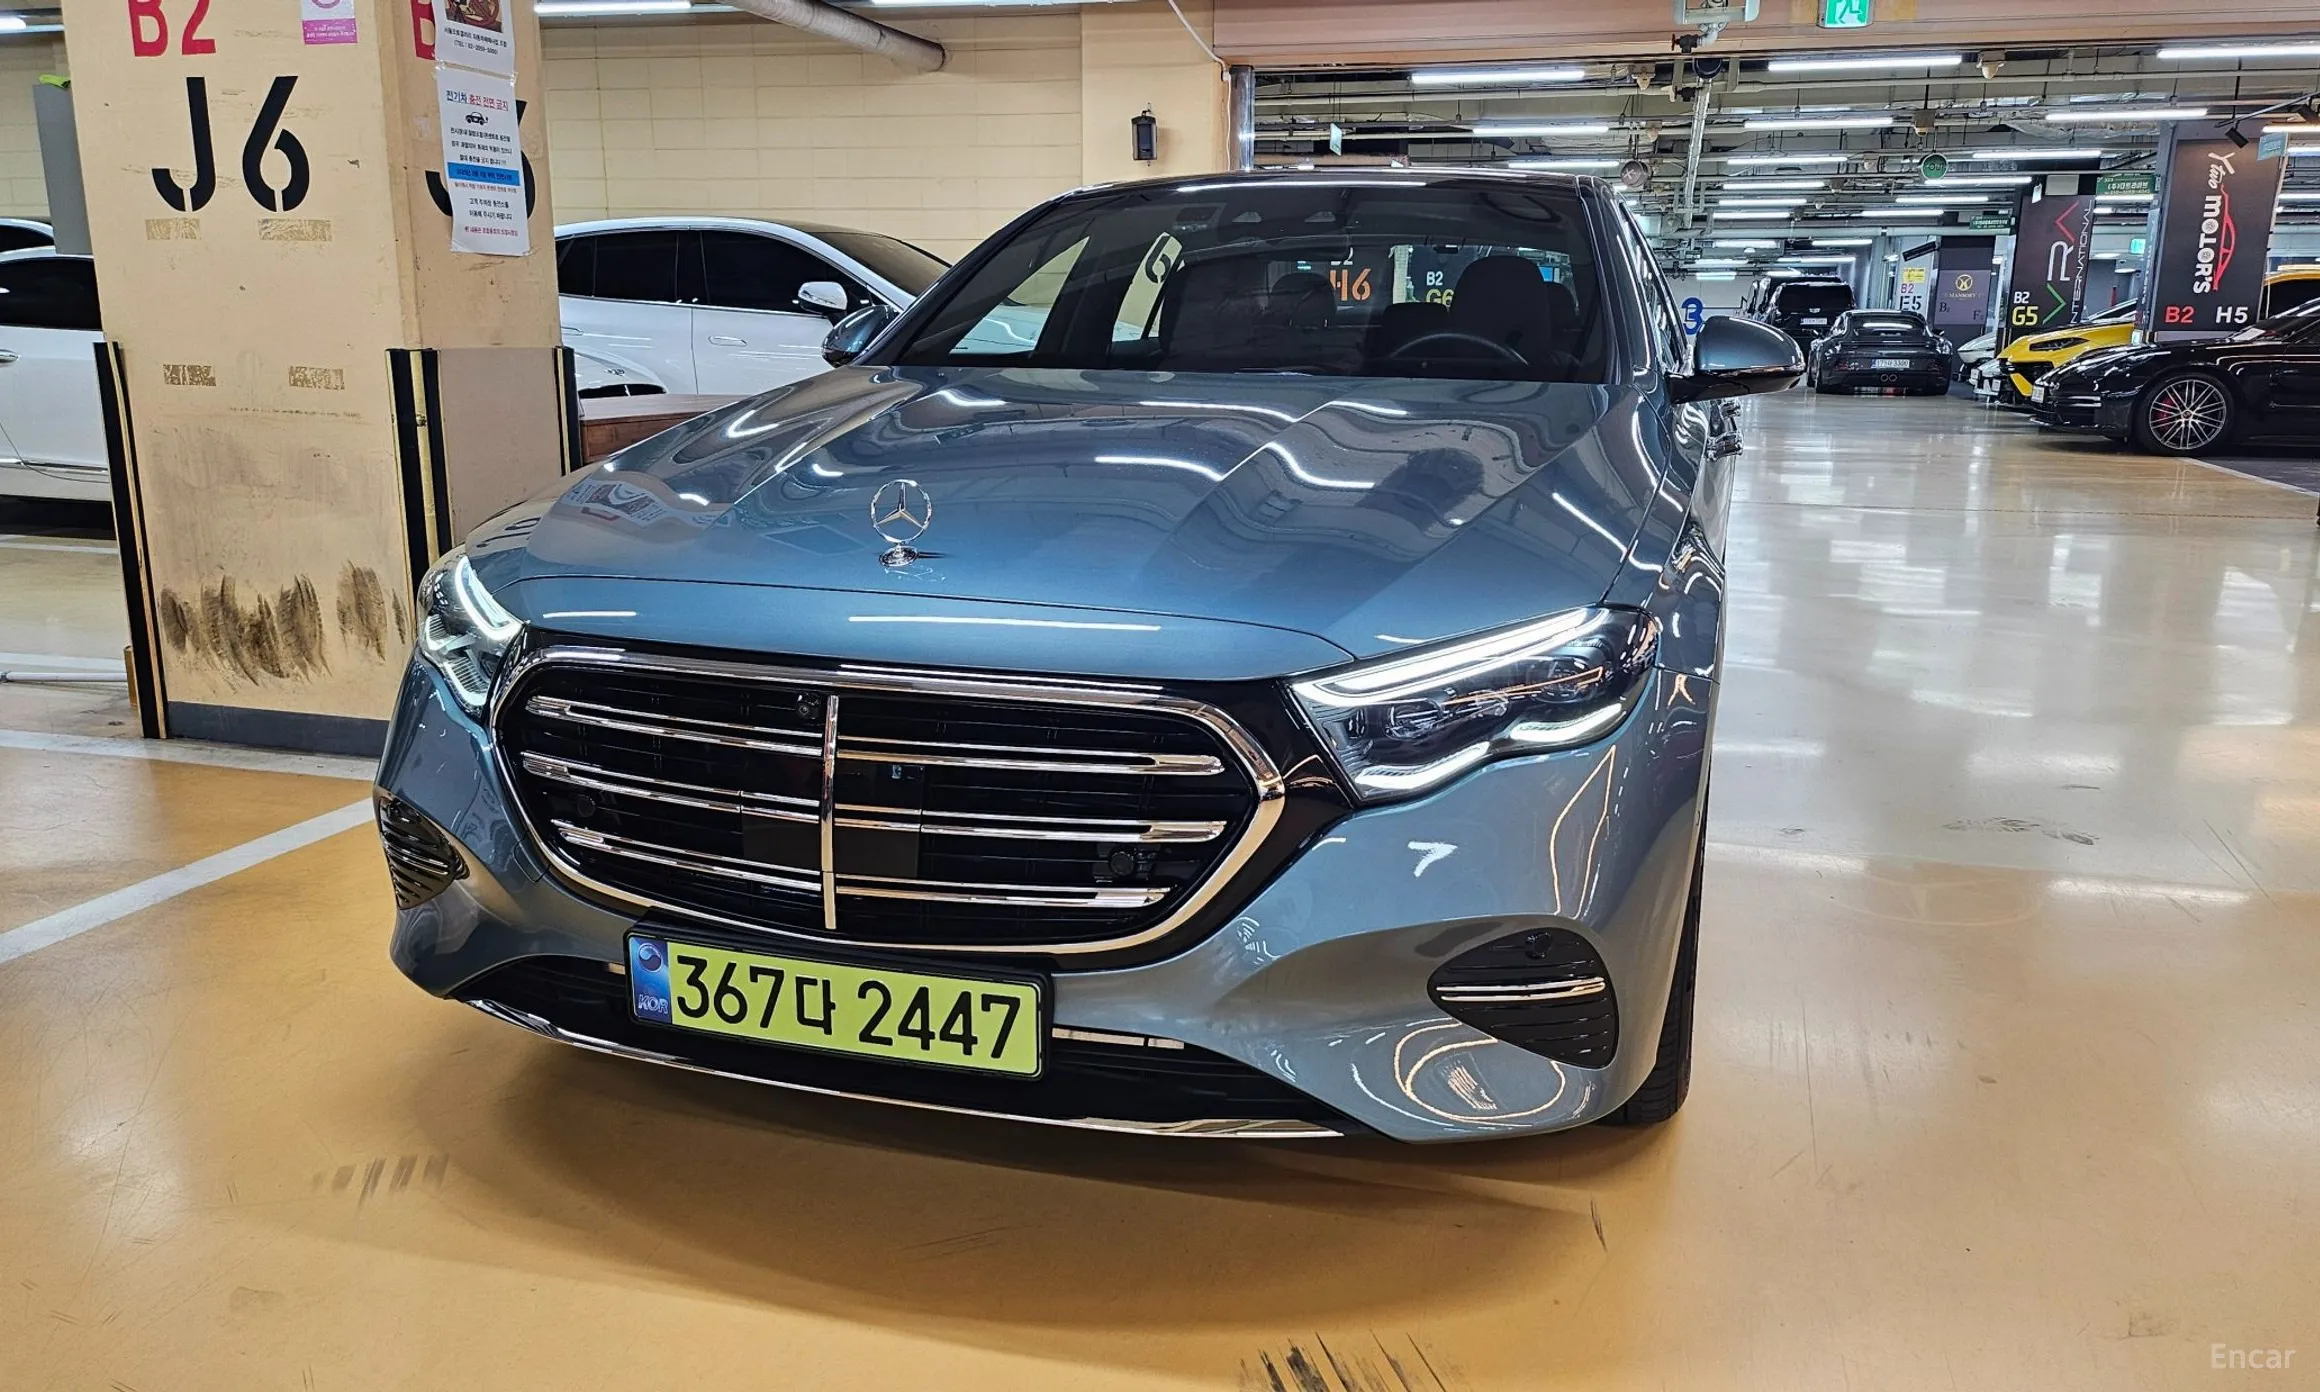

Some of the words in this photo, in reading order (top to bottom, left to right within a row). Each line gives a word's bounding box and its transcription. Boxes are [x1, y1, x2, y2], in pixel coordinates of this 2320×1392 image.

[128, 0, 216, 57] B2
[446, 90, 467, 104] 전기차
[496, 99, 509, 111] 금지
[151, 76, 310, 212] J6
[2070, 199, 2093, 325] NTERNATIONAL
[1426, 271, 1444, 286] B2
[1900, 283, 1915, 294] B2
[1900, 295, 1922, 311] E5
[2013, 291, 2031, 304] B2
[1681, 297, 1703, 335] 3
[2012, 306, 2039, 326] G5
[2165, 306, 2195, 323] B2
[2215, 306, 2249, 324] H5
[638, 993, 669, 1015] KOR
[676, 954, 836, 1036] 367다
[857, 980, 1022, 1059] 2447
